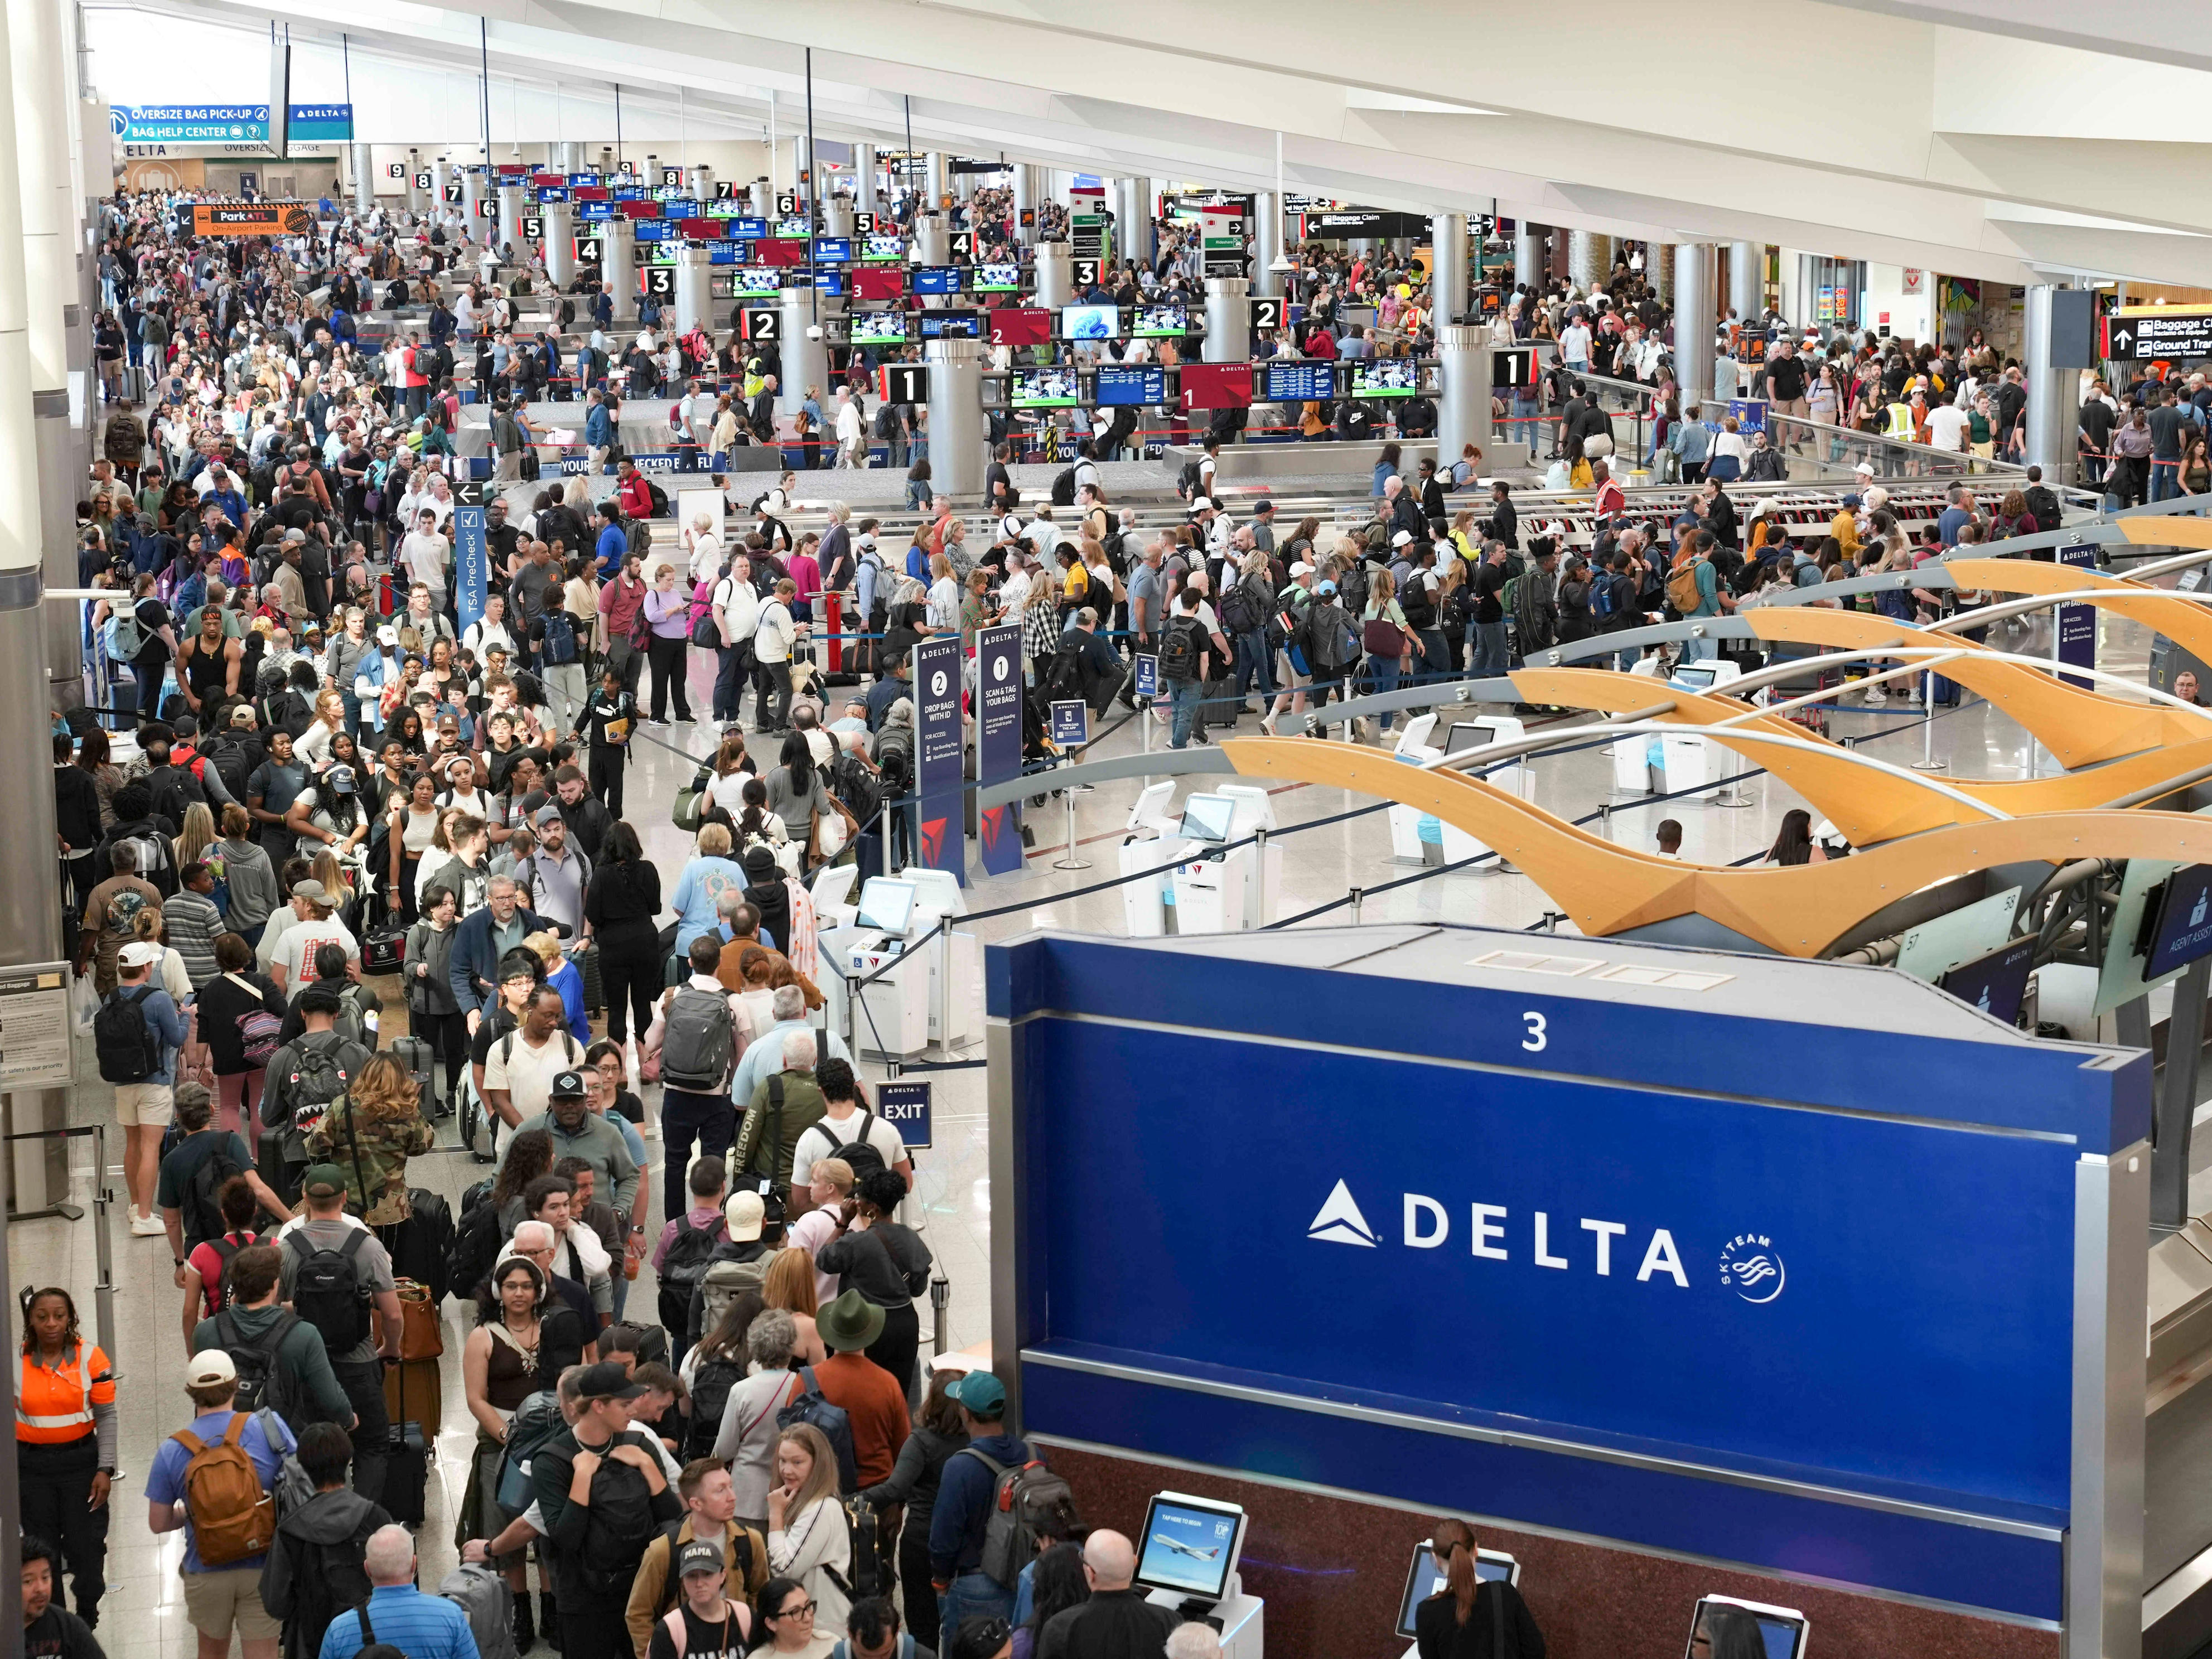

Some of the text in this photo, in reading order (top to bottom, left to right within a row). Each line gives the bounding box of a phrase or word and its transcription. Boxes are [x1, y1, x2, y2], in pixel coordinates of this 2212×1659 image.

[132, 110, 252, 119] OVERSIZE BAG PICK-UP
[132, 128, 226, 137] BAG HELP CENTER
[127, 144, 166, 156] ELTA
[392, 164, 402, 176] 9
[621, 163, 630, 173] 9
[419, 175, 428, 187] 8
[667, 172, 676, 183] 8
[449, 187, 459, 200] 7
[719, 183, 730, 196] 7
[484, 201, 495, 216] 6
[781, 197, 792, 212] 6
[288, 215, 307, 226] DETOUR
[858, 214, 870, 231] 5
[528, 220, 539, 236] 5
[683, 231, 689, 240] 5
[582, 241, 597, 260] 4
[953, 235, 968, 253] 4
[757, 254, 765, 264] 4
[1079, 263, 1093, 283] 3
[654, 270, 668, 292] 3
[854, 284, 862, 297] 3
[1257, 303, 1275, 327] 2
[756, 314, 774, 338] 2
[2154, 320, 2200, 331] Baggage
[993, 329, 1002, 344] 2
[2153, 340, 2190, 350] Ground
[1508, 355, 1516, 383] 1
[904, 371, 914, 400] 1
[1184, 389, 1192, 406] 1
[1057, 447, 1078, 458] YOU
[561, 457, 672, 472] YOUR HECKED
[2069, 551, 2088, 559] DELTA
[465, 534, 477, 612] PreCheck TSA
[991, 633, 1012, 643] DELTA
[928, 647, 950, 657] DELTA
[998, 661, 1003, 675] 1
[936, 676, 943, 691] 2
[986, 689, 999, 698] SCAN
[1004, 685, 1016, 694] TAG
[925, 700, 955, 713] DROP BAGS
[986, 694, 1016, 707] YOUR BAGS
[596, 705, 614, 717] PUMA
[929, 712, 944, 722] WITH
[112, 888, 123, 897] 931
[2004, 894, 2016, 911] 58
[1907, 933, 1919, 950] 57
[2169, 925, 2212, 954] AGENT ASSIST
[2010, 949, 2028, 962] DELTA
[1522, 1011, 1547, 1051] 3
[885, 1104, 924, 1119] EXIT
[734, 1108, 757, 1174] FREEDOM
[1403, 1193, 1689, 1288] DELTA
[1720, 1233, 1770, 1285] SKYTEAM
[684, 1547, 712, 1560] MAMA
